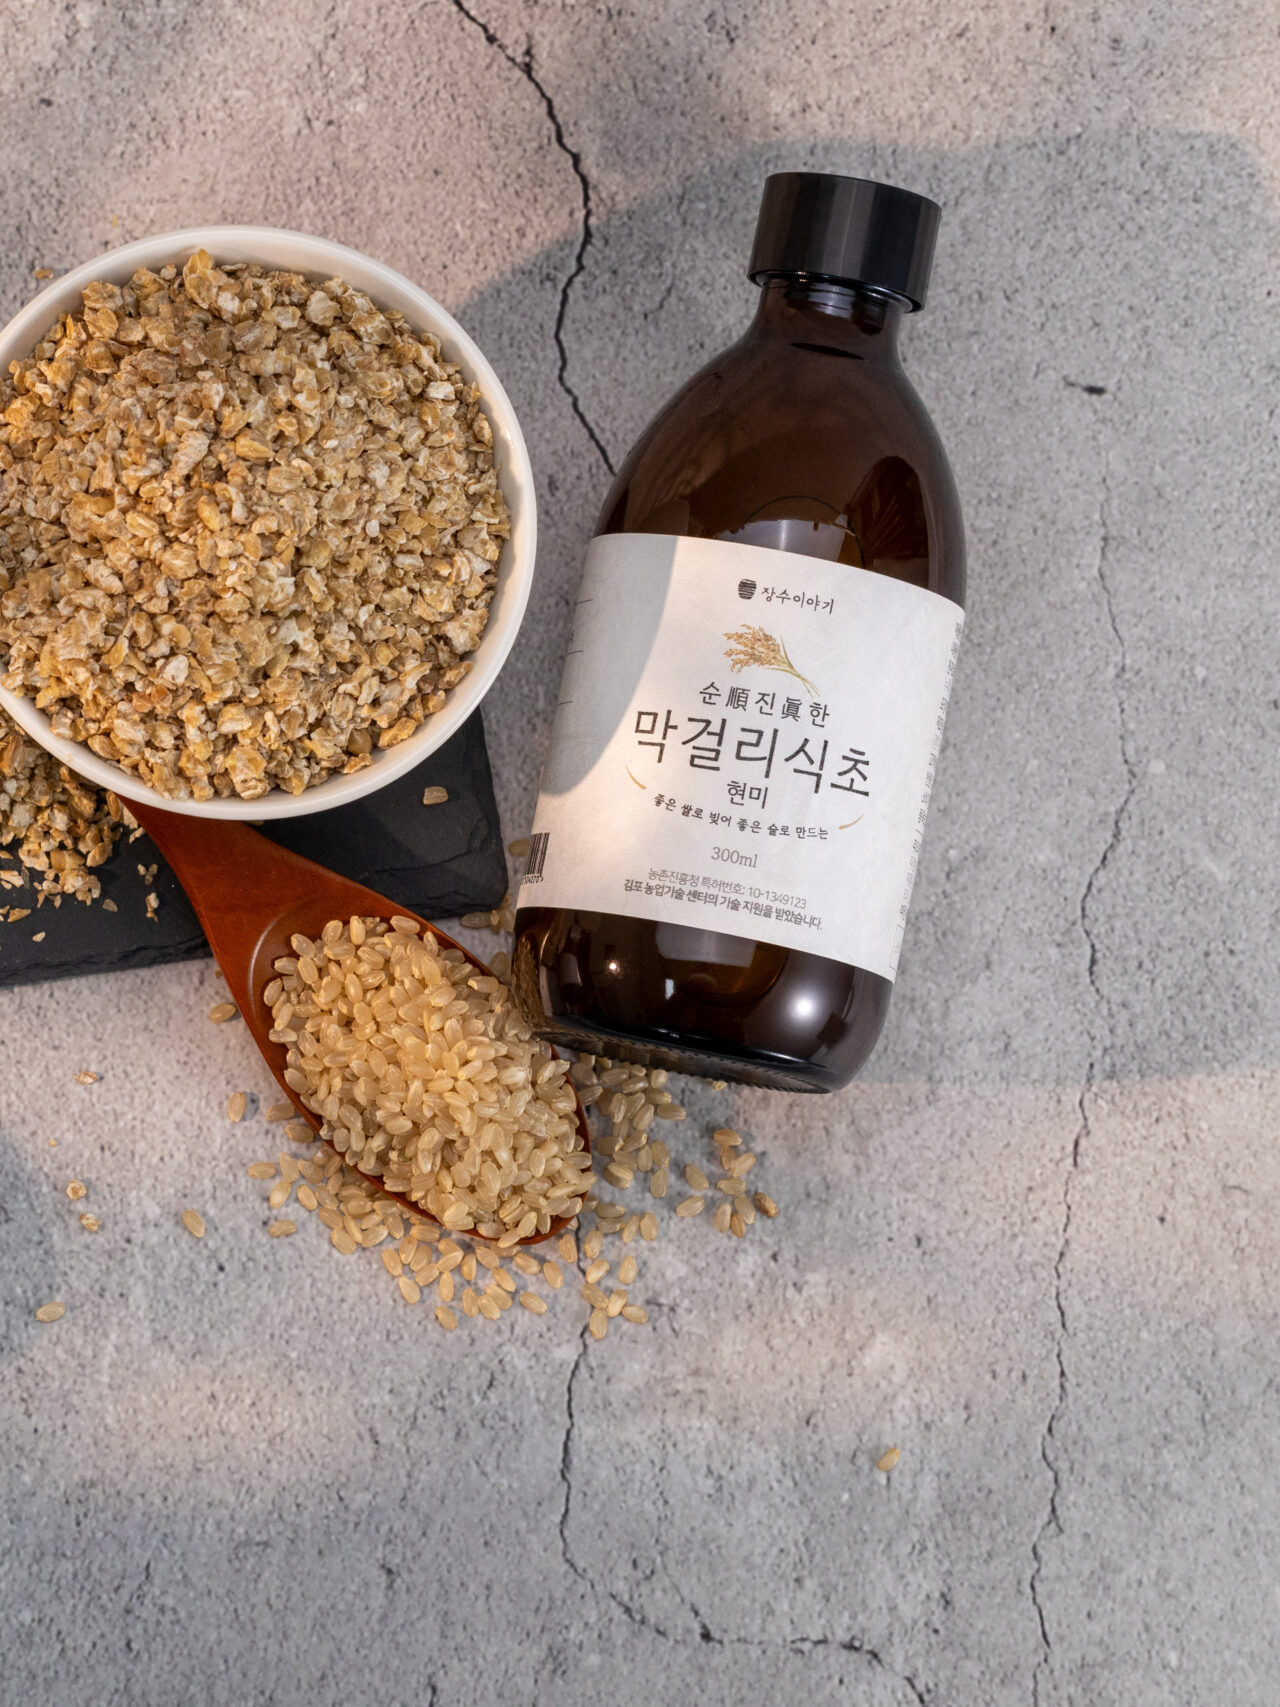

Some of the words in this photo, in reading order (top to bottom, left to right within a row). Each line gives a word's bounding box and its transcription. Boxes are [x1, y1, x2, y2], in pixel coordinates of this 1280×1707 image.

[761, 586, 835, 615] 장수이야기
[634, 709, 870, 798] 막걸리식초
[653, 793, 677, 812] 좋은
[680, 803, 704, 820] 쌀로
[709, 811, 732, 828] 빚어
[736, 817, 763, 834] 좋은
[766, 823, 791, 837] 술로
[795, 826, 829, 840] 만드는
[726, 780, 769, 810] 현미
[710, 846, 759, 869] 300ml
[623, 878, 644, 893] 김포
[643, 881, 686, 901] 농업기술
[685, 889, 720, 907] 센터의
[719, 895, 742, 912] 기술
[741, 900, 774, 919] 지원을
[774, 906, 822, 931] 받았습니다.
[647, 867, 701, 888] 농촌진흥청
[699, 876, 747, 896] 특허번호:
[747, 886, 808, 910] 10-1349123
